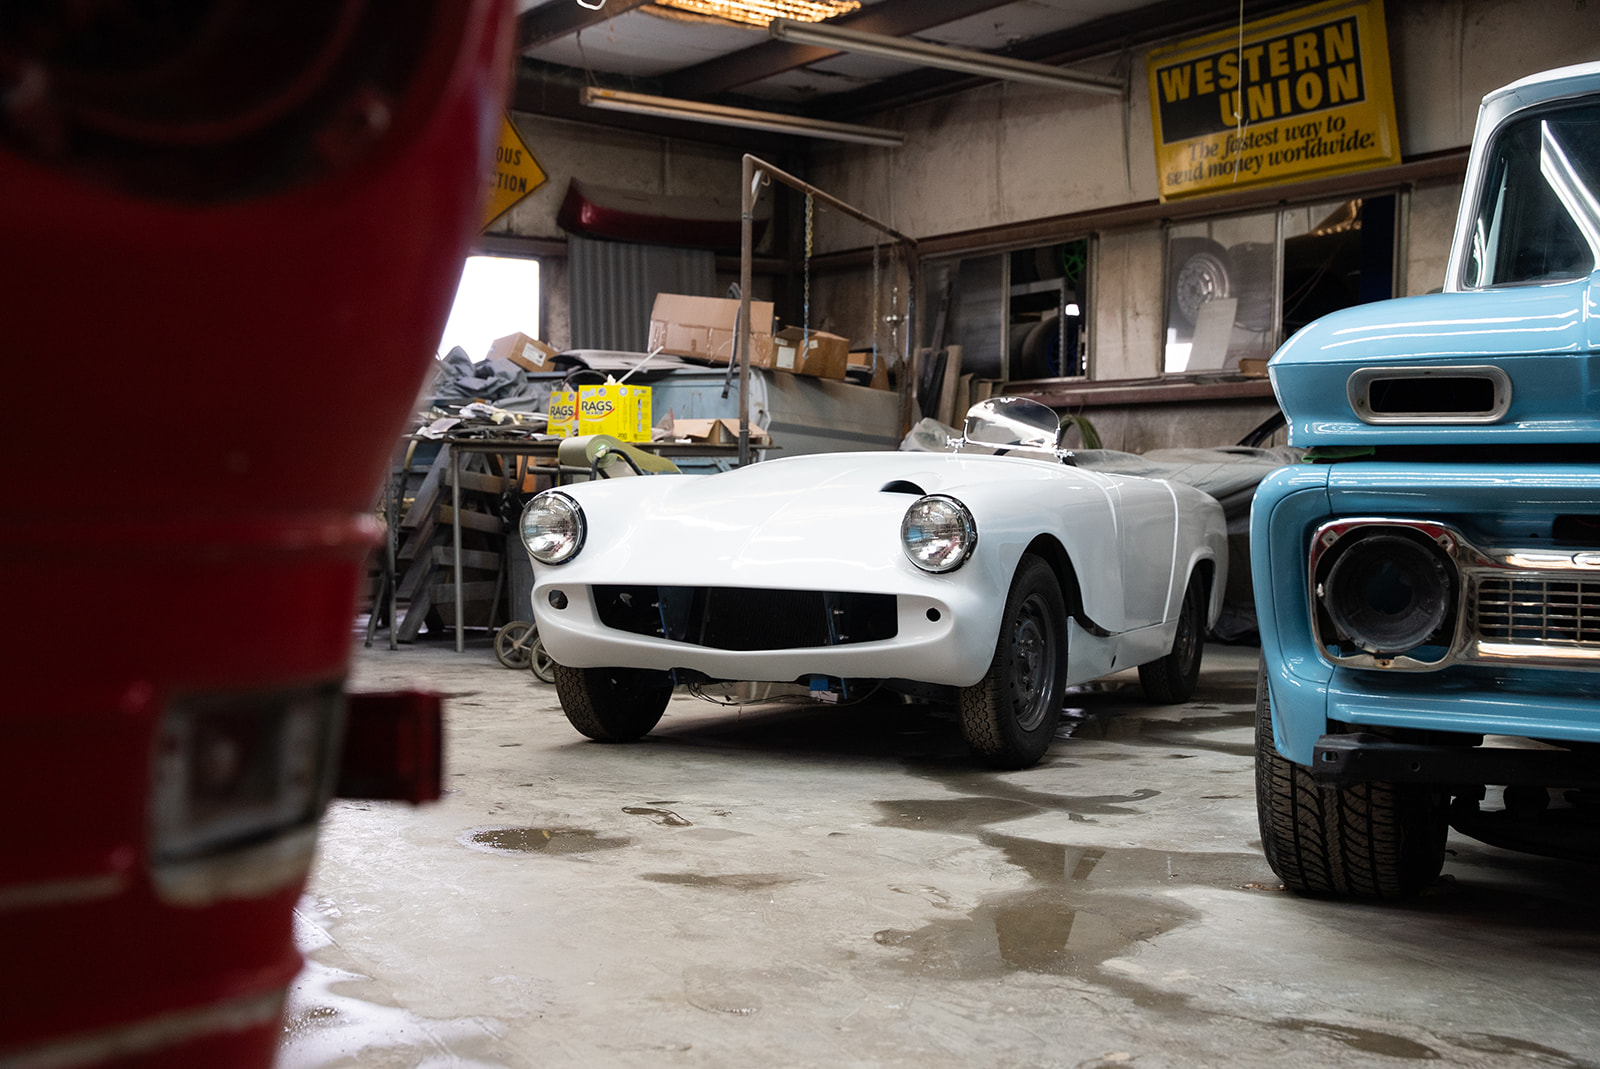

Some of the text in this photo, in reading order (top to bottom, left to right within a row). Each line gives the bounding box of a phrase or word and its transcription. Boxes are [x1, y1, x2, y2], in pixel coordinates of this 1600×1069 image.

[1160, 22, 1355, 103] WESTERN
[1219, 63, 1359, 127] UNION
[496, 146, 521, 166] OUS
[1167, 130, 1375, 186] send money worldwide.
[1188, 115, 1346, 162] The fastest way to
[550, 406, 574, 416] RAGS
[581, 401, 612, 411] RAGS
